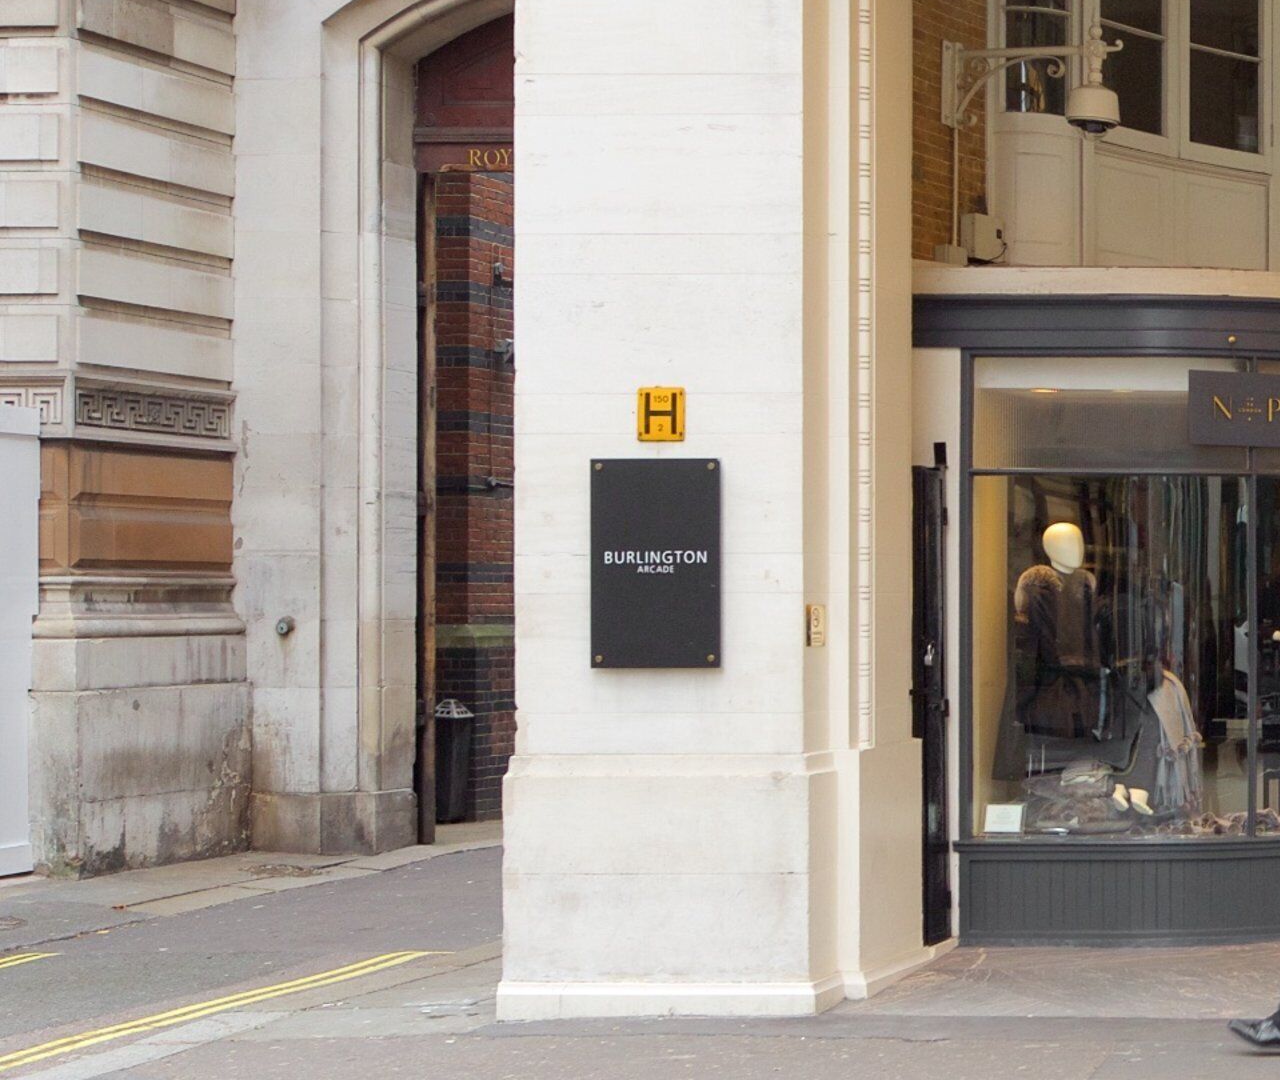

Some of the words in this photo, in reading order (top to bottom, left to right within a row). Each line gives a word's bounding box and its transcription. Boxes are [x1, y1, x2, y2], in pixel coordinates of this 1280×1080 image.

[657, 423, 664, 432] 2
[604, 550, 708, 564] BURLINGTON
[637, 565, 675, 573] ARCADE
